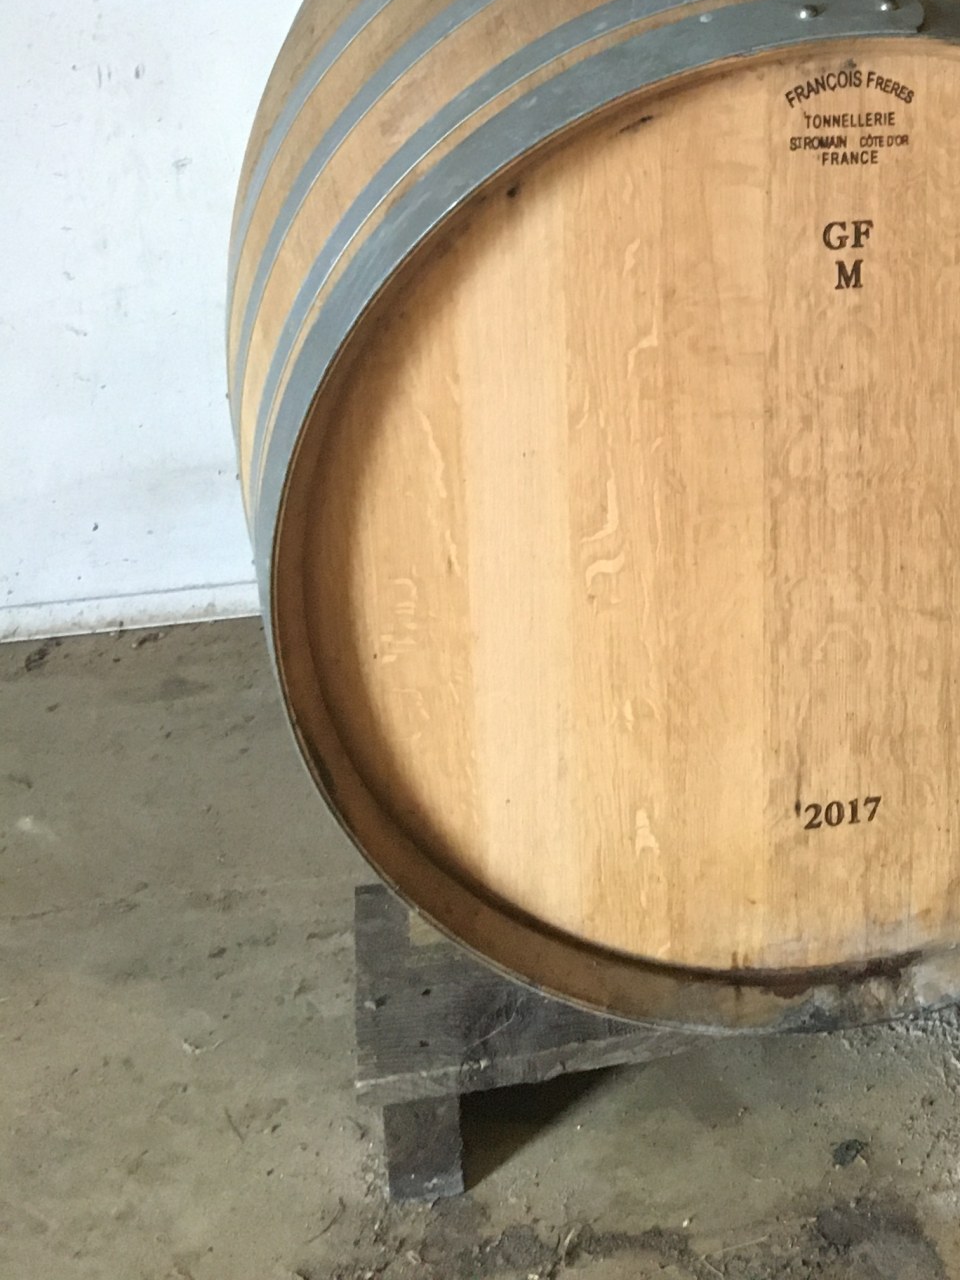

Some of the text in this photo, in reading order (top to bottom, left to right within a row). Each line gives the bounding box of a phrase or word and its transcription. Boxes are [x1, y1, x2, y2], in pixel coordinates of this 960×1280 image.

[785, 70, 862, 108] FRANÇOIS
[804, 112, 895, 129] TONNELLERIE
[803, 135, 848, 150] ROMAIN
[821, 150, 879, 166] FRANCE
[822, 219, 874, 250] GF
[834, 258, 864, 290] M
[803, 795, 882, 830] 2017
